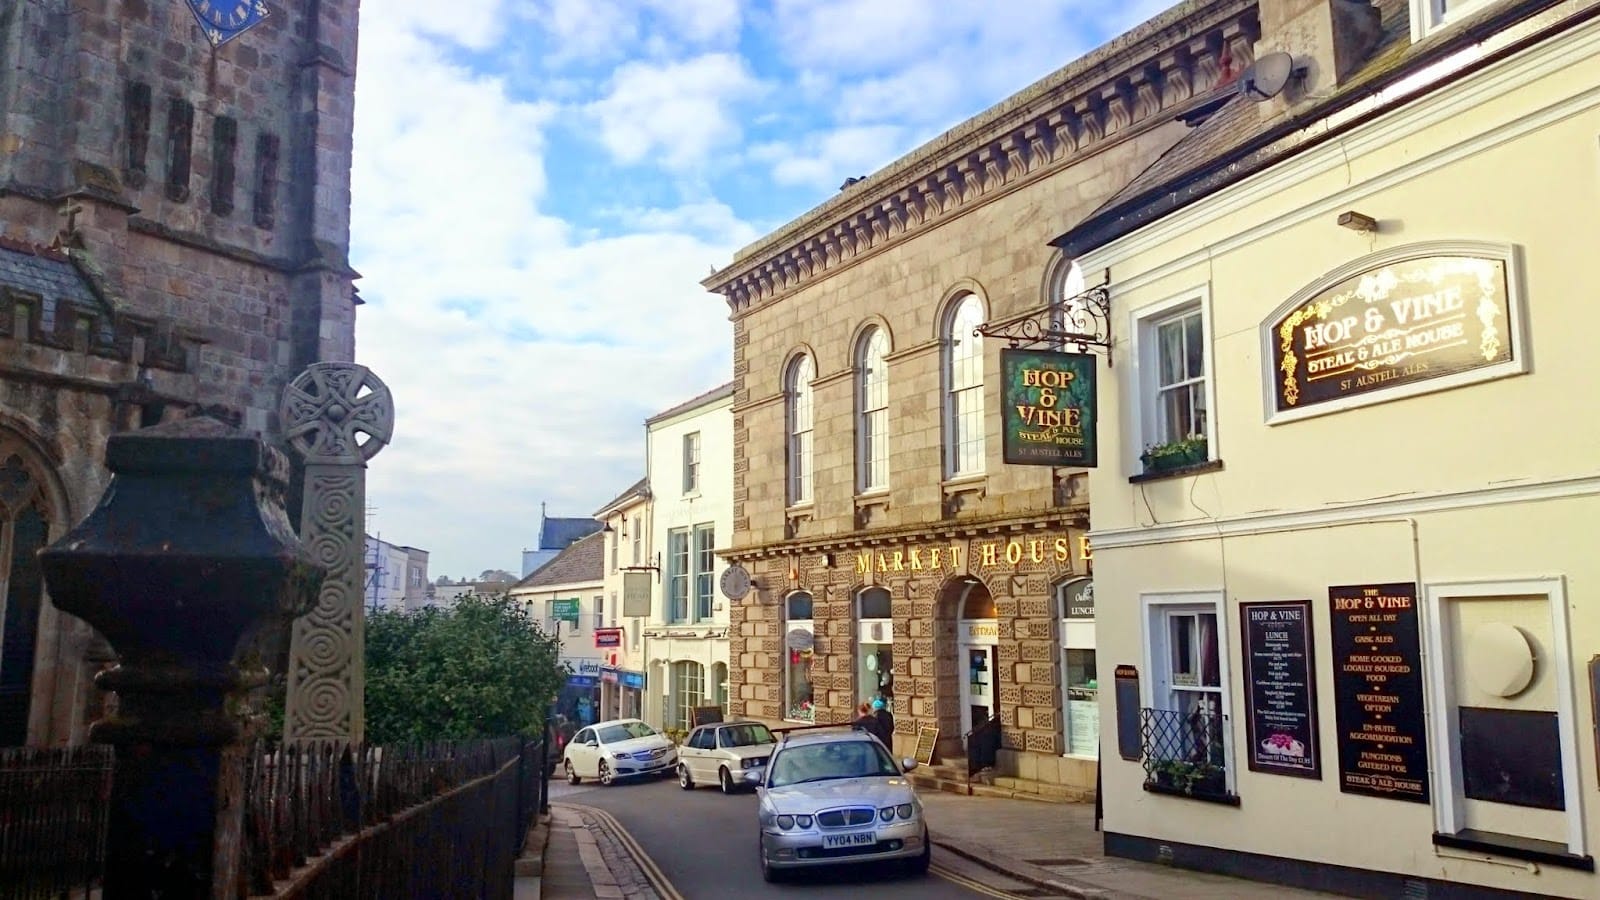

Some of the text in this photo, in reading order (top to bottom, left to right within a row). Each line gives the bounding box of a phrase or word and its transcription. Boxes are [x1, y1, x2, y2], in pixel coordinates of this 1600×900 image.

[1304, 287, 1463, 350] HOP & VINE
[1308, 323, 1464, 373] STEAK & ALE HOUSE
[1022, 369, 1074, 388] HOP
[1340, 362, 1429, 391] ST AUSTELL ALES
[1040, 388, 1057, 408] &
[1016, 405, 1081, 428] VINE
[1019, 431, 1052, 442] STEAK
[1062, 427, 1081, 435] ALE
[1056, 437, 1084, 446] HOUSE
[1018, 448, 1082, 458] ST AUSTELL ALES
[857, 536, 1094, 574] MARKET HOUSE
[1335, 596, 1411, 609] HOP & VINE
[1251, 610, 1301, 621] HOP & VINE
[1265, 632, 1289, 640] LUNCH
[1343, 664, 1410, 673] LOCALLY SOURCED
[1356, 694, 1400, 703] VEGETARIAN
[1364, 704, 1392, 712] OPTION
[1350, 732, 1413, 744] ACCOMMODATION
[1361, 752, 1402, 763] FUNCTIONS
[1358, 761, 1407, 773] CATERED FOR
[1347, 775, 1370, 785] STEAK
[1378, 778, 1393, 787] ALE
[1394, 780, 1422, 791] HOUSE
[827, 832, 872, 847] YY04 NBN
